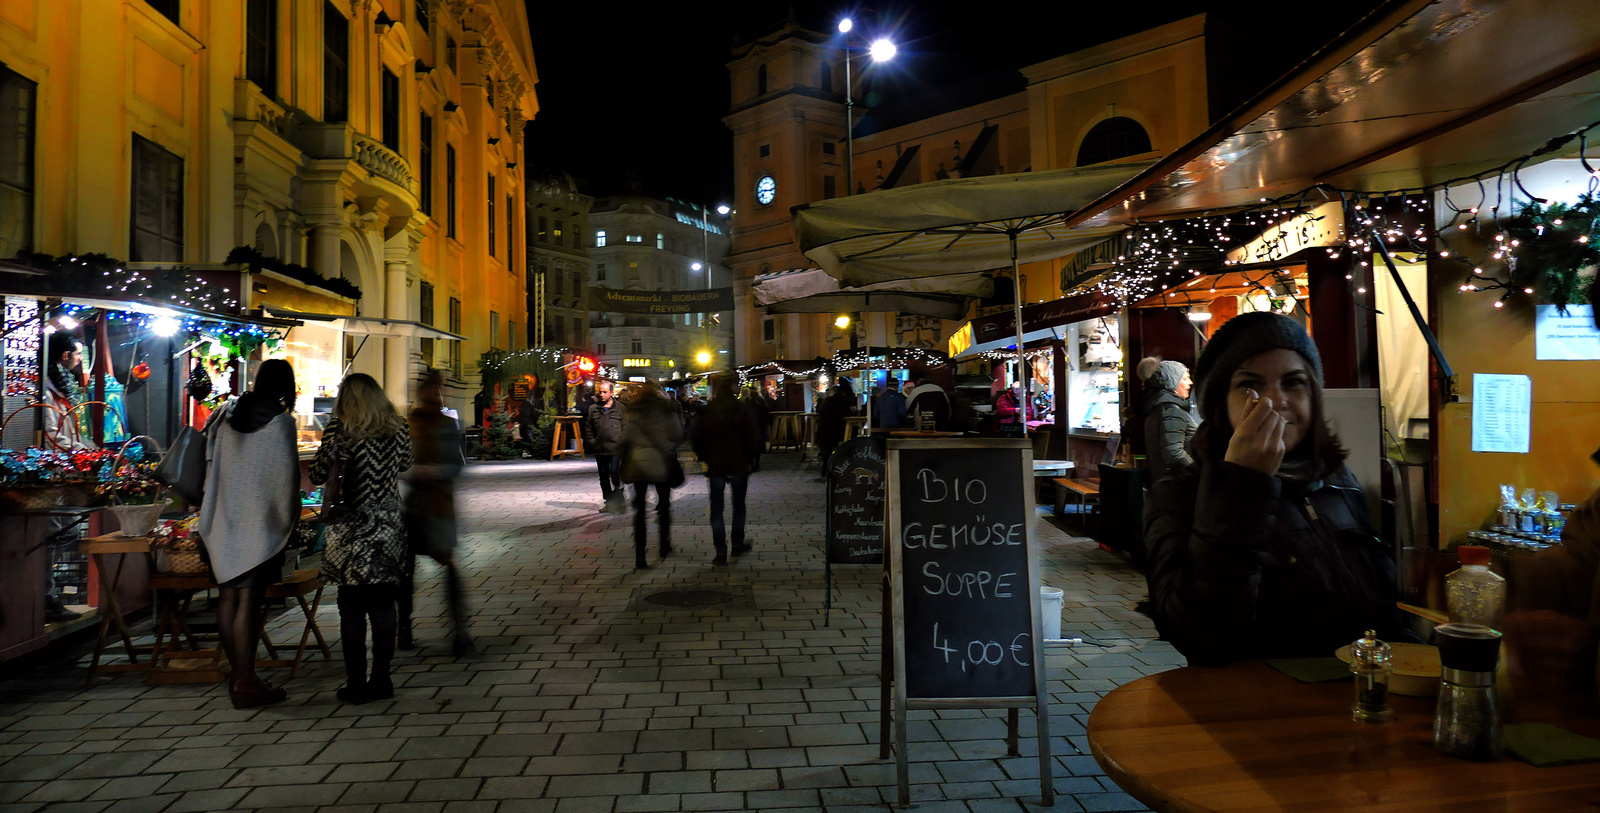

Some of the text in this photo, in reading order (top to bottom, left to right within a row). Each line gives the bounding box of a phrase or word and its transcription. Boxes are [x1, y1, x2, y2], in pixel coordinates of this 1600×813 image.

[606, 291, 720, 302] Adventmarkt BIOBAUERN
[650, 304, 691, 313] FREYUNG
[917, 468, 987, 504] BIO
[903, 514, 1023, 549] GEMÜSE
[933, 621, 1031, 672] 4,00€
